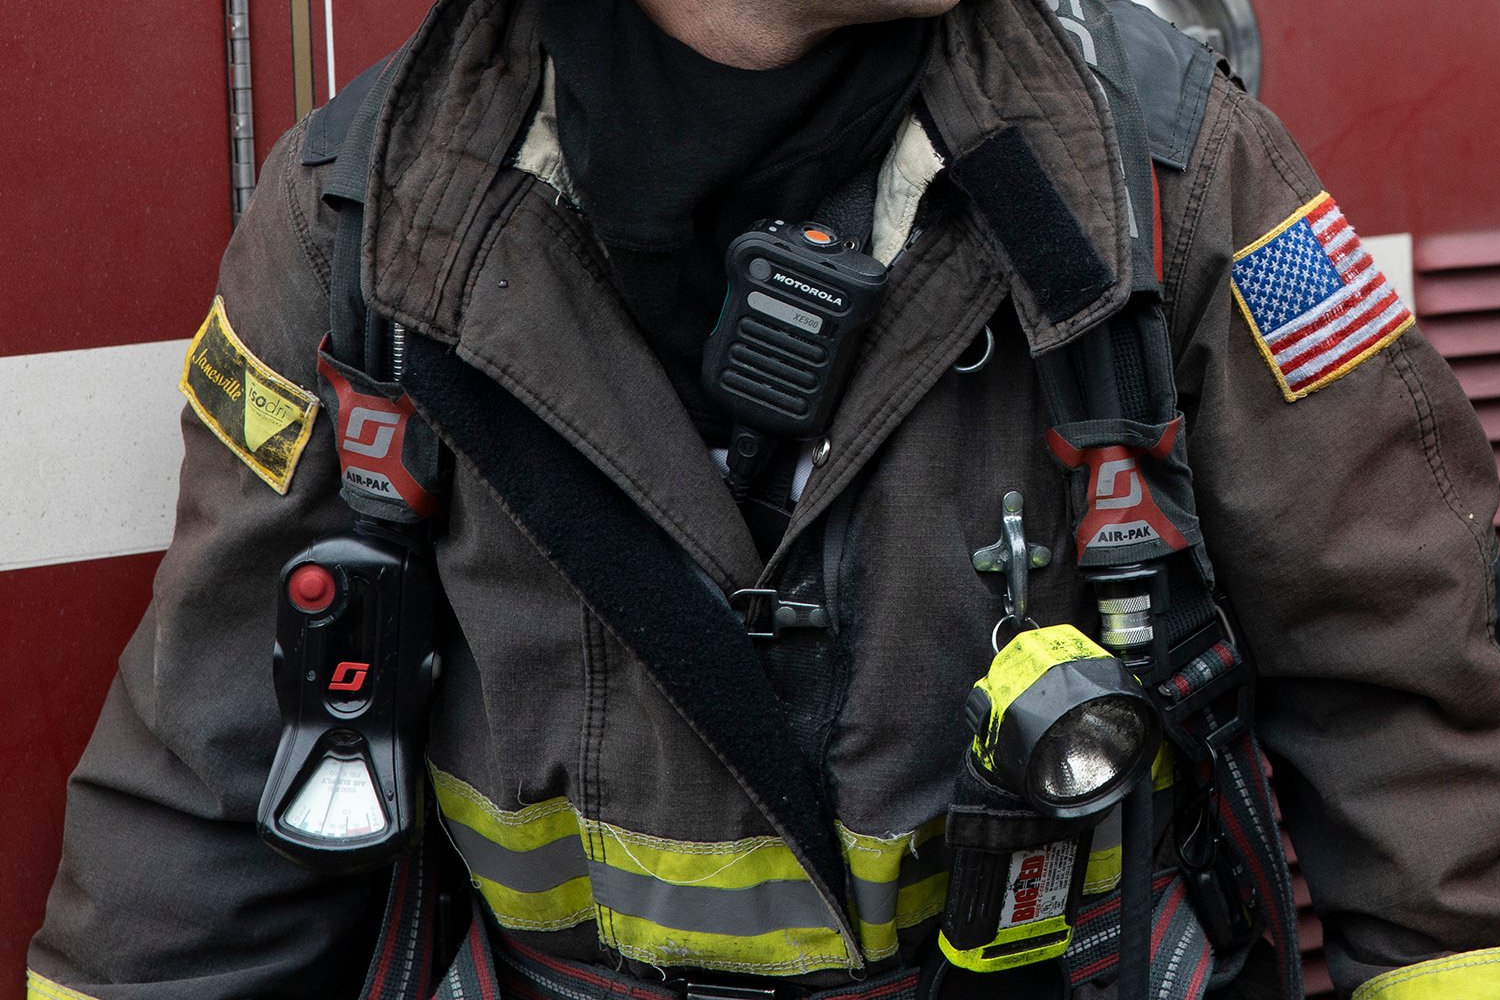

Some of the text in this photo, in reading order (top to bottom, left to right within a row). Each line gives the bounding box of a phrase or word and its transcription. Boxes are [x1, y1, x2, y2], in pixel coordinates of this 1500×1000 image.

[773, 272, 843, 306] MOTOROLA
[792, 312, 820, 329] XE500
[191, 347, 242, 402] Janesville
[346, 470, 391, 494] AIR-PAK
[1097, 525, 1151, 543] AIR-PAK
[1011, 855, 1045, 923] BIG ED
